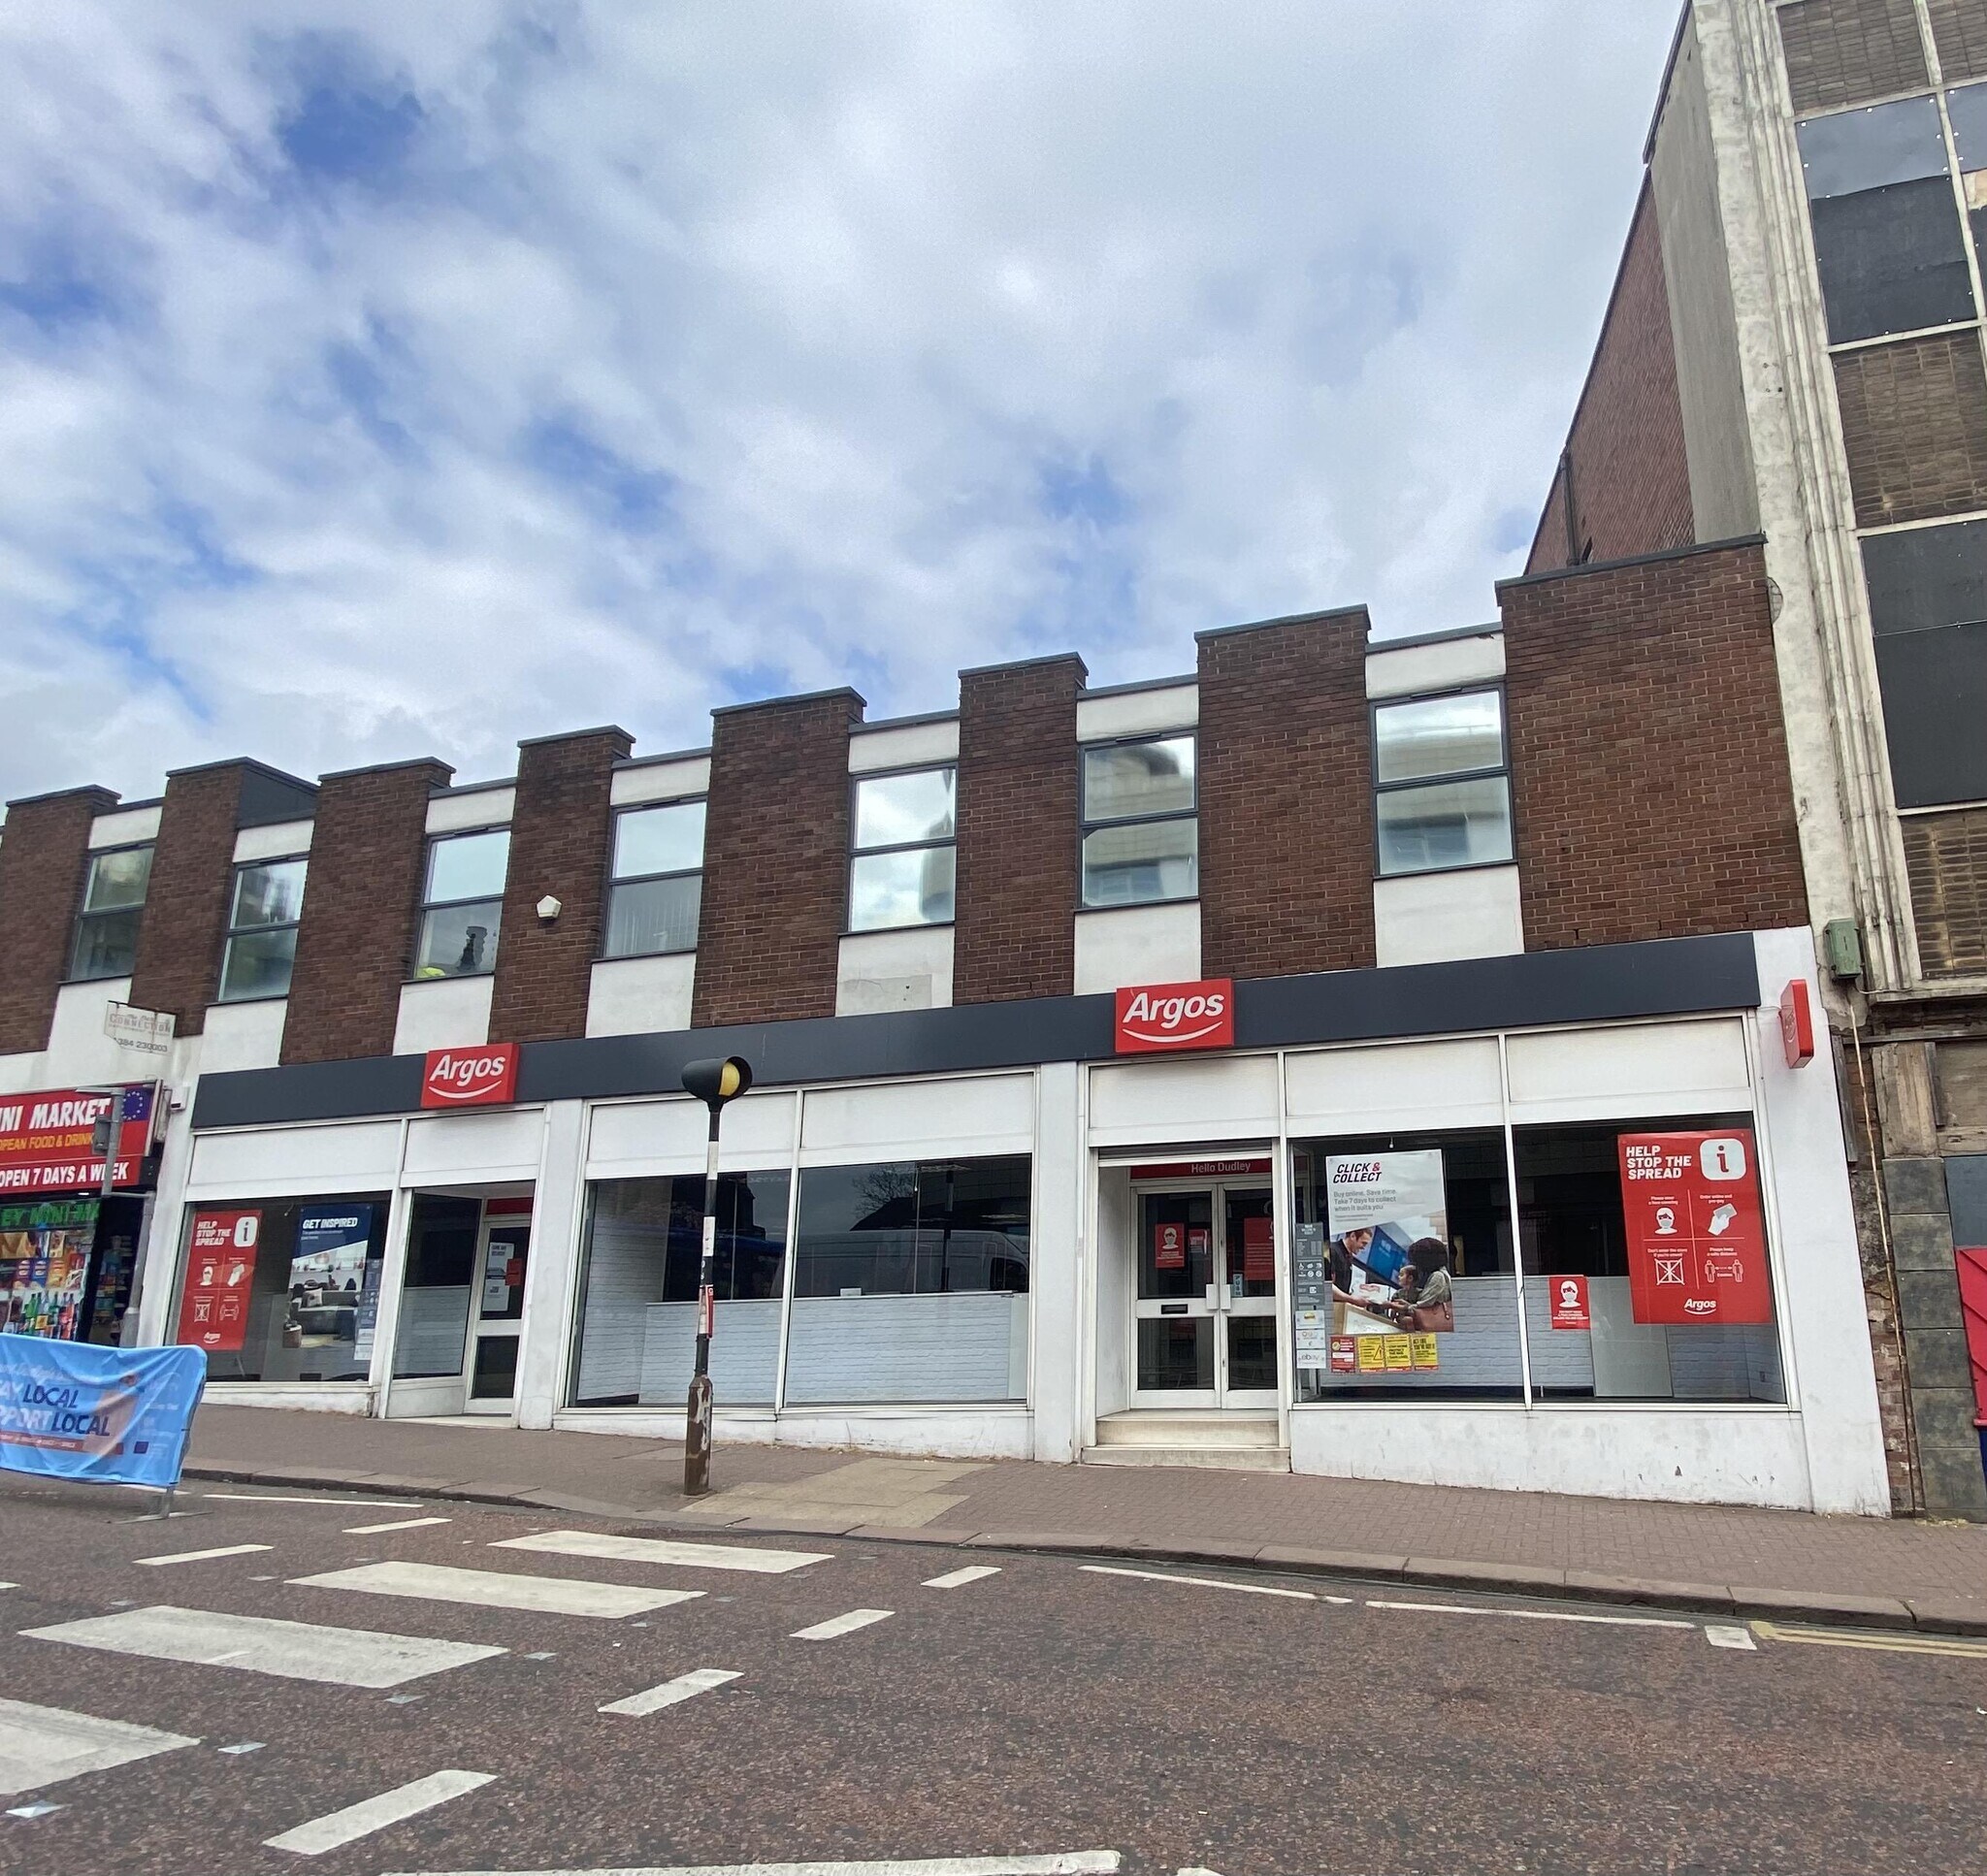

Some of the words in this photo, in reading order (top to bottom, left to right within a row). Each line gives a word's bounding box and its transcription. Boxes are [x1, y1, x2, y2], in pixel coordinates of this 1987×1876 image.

[1123, 992, 1224, 1028] Argos
[429, 1054, 505, 1086] Argos
[29, 1098, 112, 1129] MARKET
[29, 1135, 55, 1148] FOOD
[56, 1135, 63, 1147] &
[1626, 1146, 1661, 1157] HELP
[1191, 1163, 1216, 1174] Hello
[1218, 1161, 1252, 1173] Dudley
[1337, 1163, 1371, 1174] CLICK
[1372, 1162, 1381, 1172] &
[1627, 1157, 1662, 1169] STOP
[1665, 1155, 1692, 1167] THE
[33, 1168, 41, 1185] 7
[43, 1166, 76, 1184] DAYS
[78, 1165, 87, 1182] A
[1333, 1172, 1382, 1183] COLLECT
[1628, 1167, 1682, 1180] SPREAD
[197, 1220, 217, 1229] HELP
[303, 1219, 321, 1229] GET
[320, 1217, 358, 1228] INSPIRED
[196, 1229, 216, 1238] STOP
[217, 1228, 232, 1237] THE
[195, 1237, 224, 1246] SPREAD
[1684, 1298, 1716, 1310] Argos
[22, 1384, 79, 1408] LOCAL
[51, 1411, 110, 1437] LOCAL
